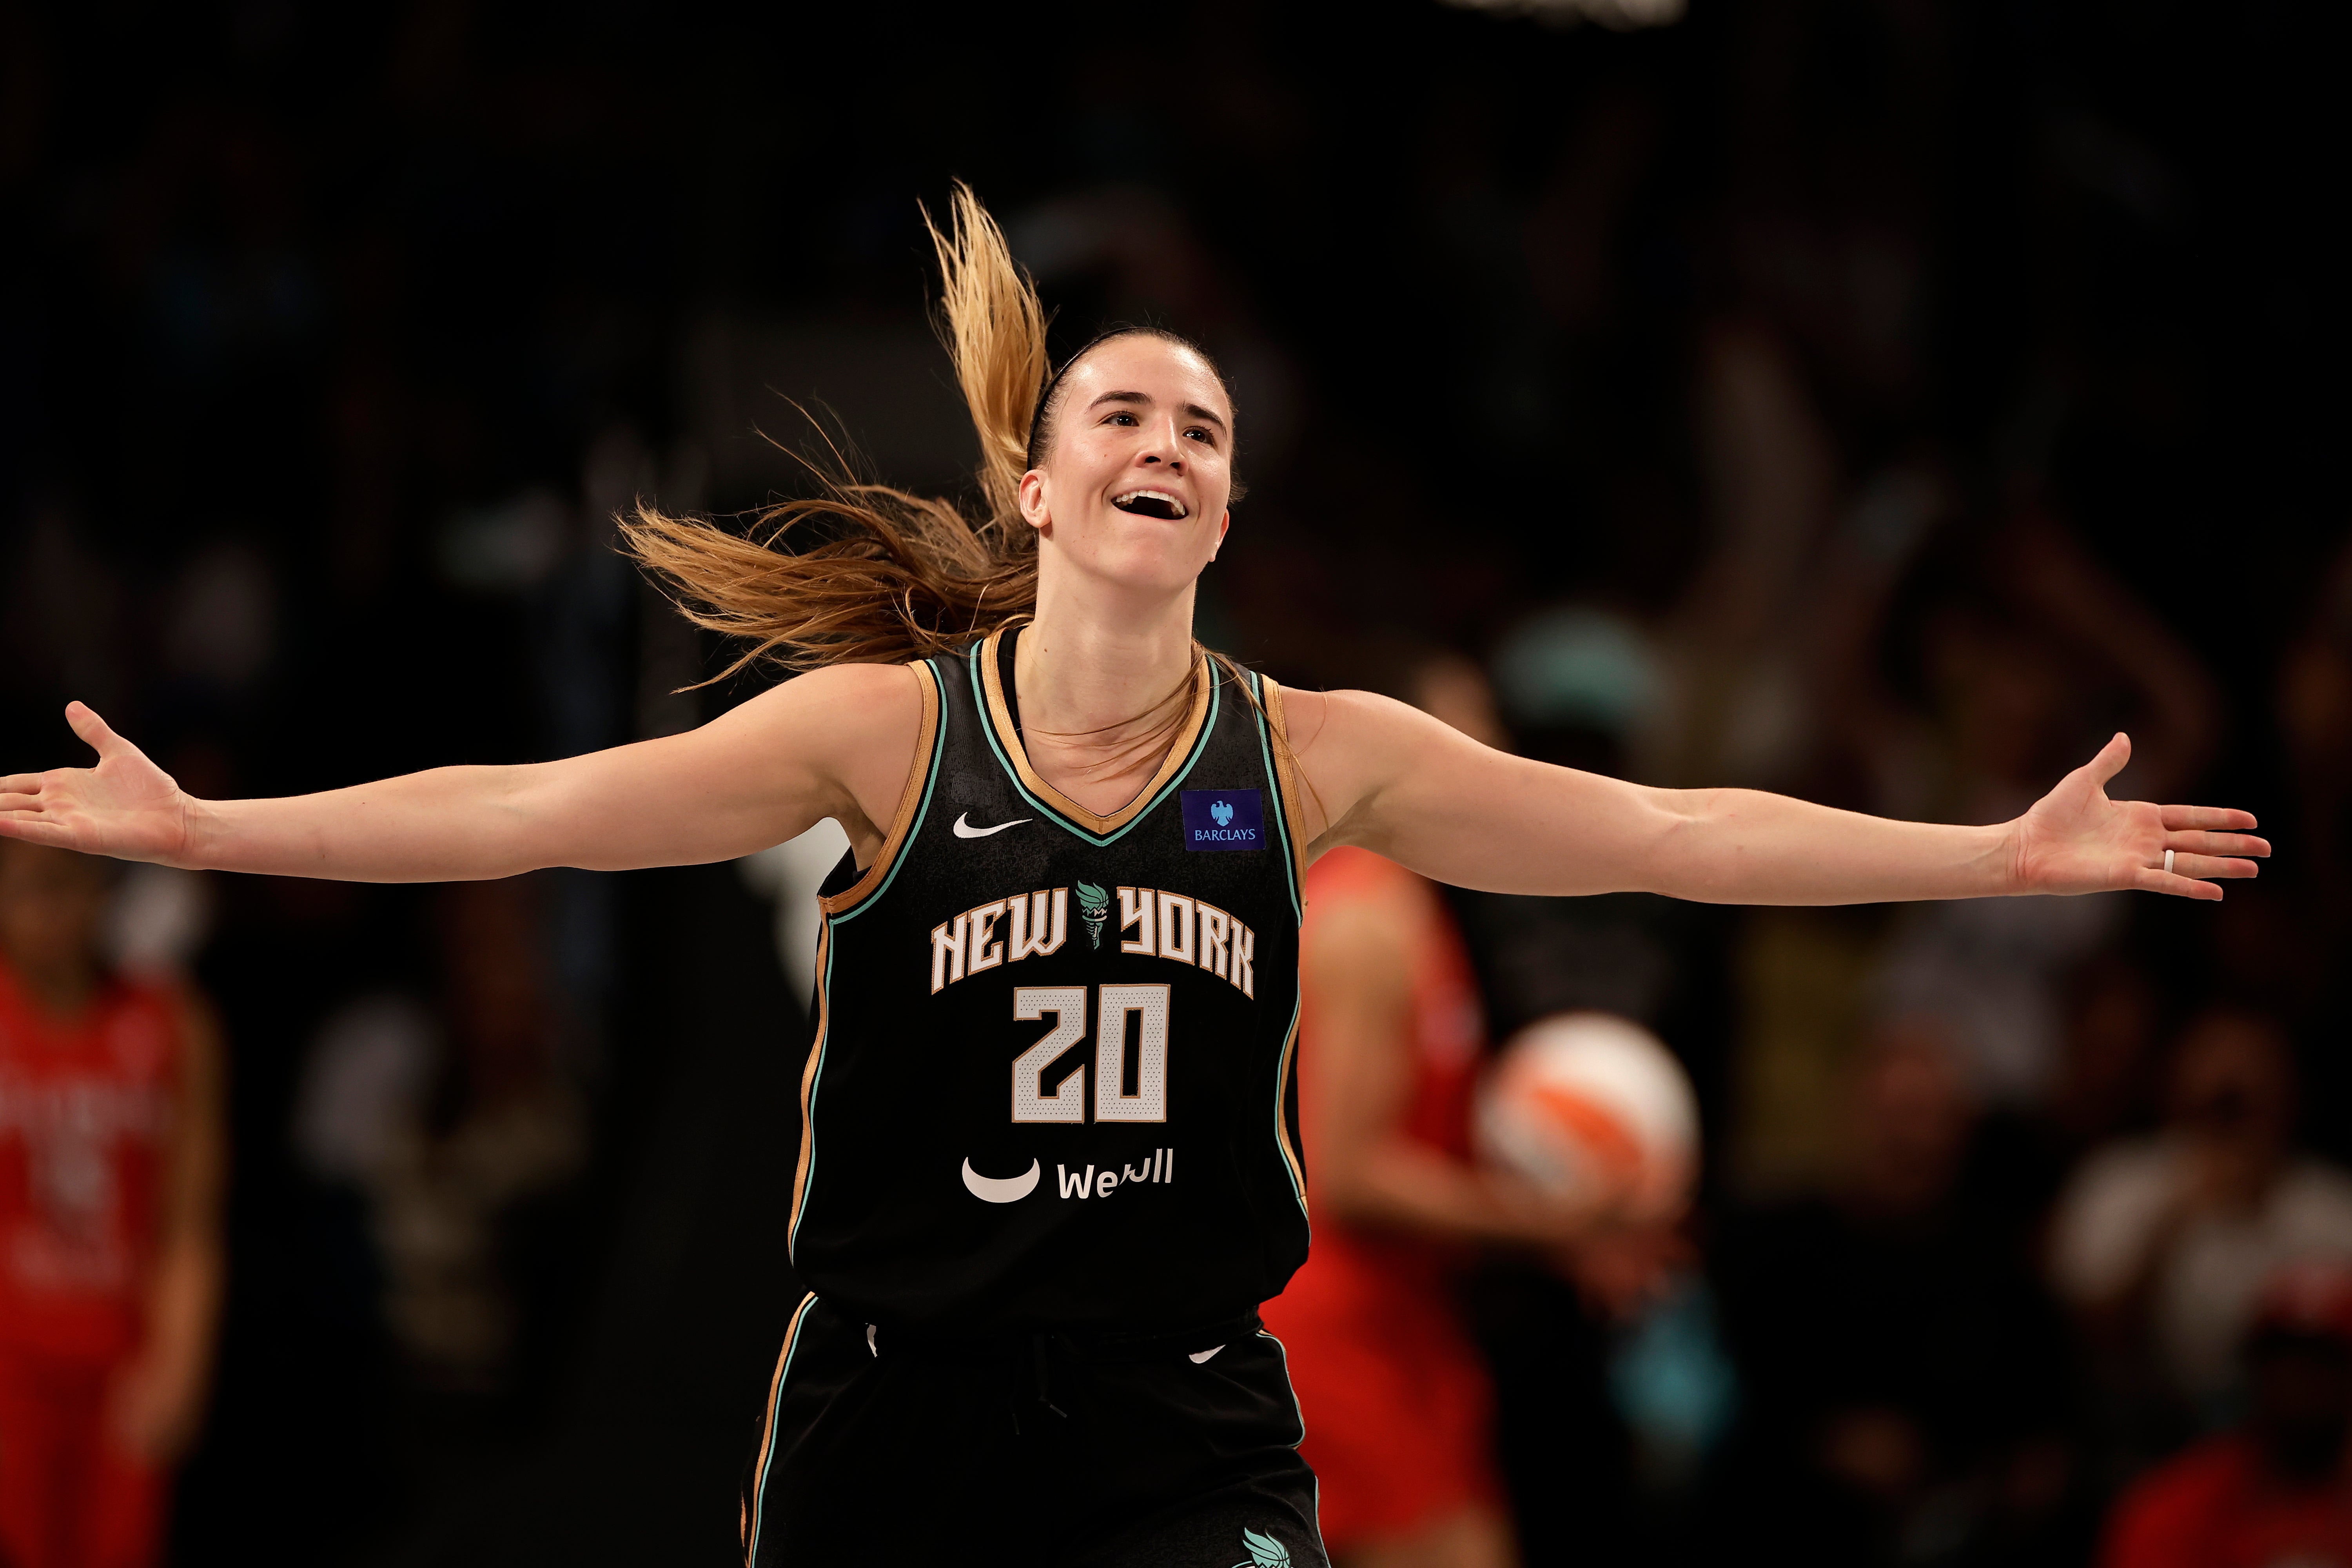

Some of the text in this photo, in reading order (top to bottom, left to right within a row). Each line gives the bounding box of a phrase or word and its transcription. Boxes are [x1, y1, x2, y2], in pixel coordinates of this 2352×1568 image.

[1194, 828, 1256, 841] BARCLAYS
[931, 886, 1254, 1000] NEW YORK
[1011, 984, 1171, 1124] 20
